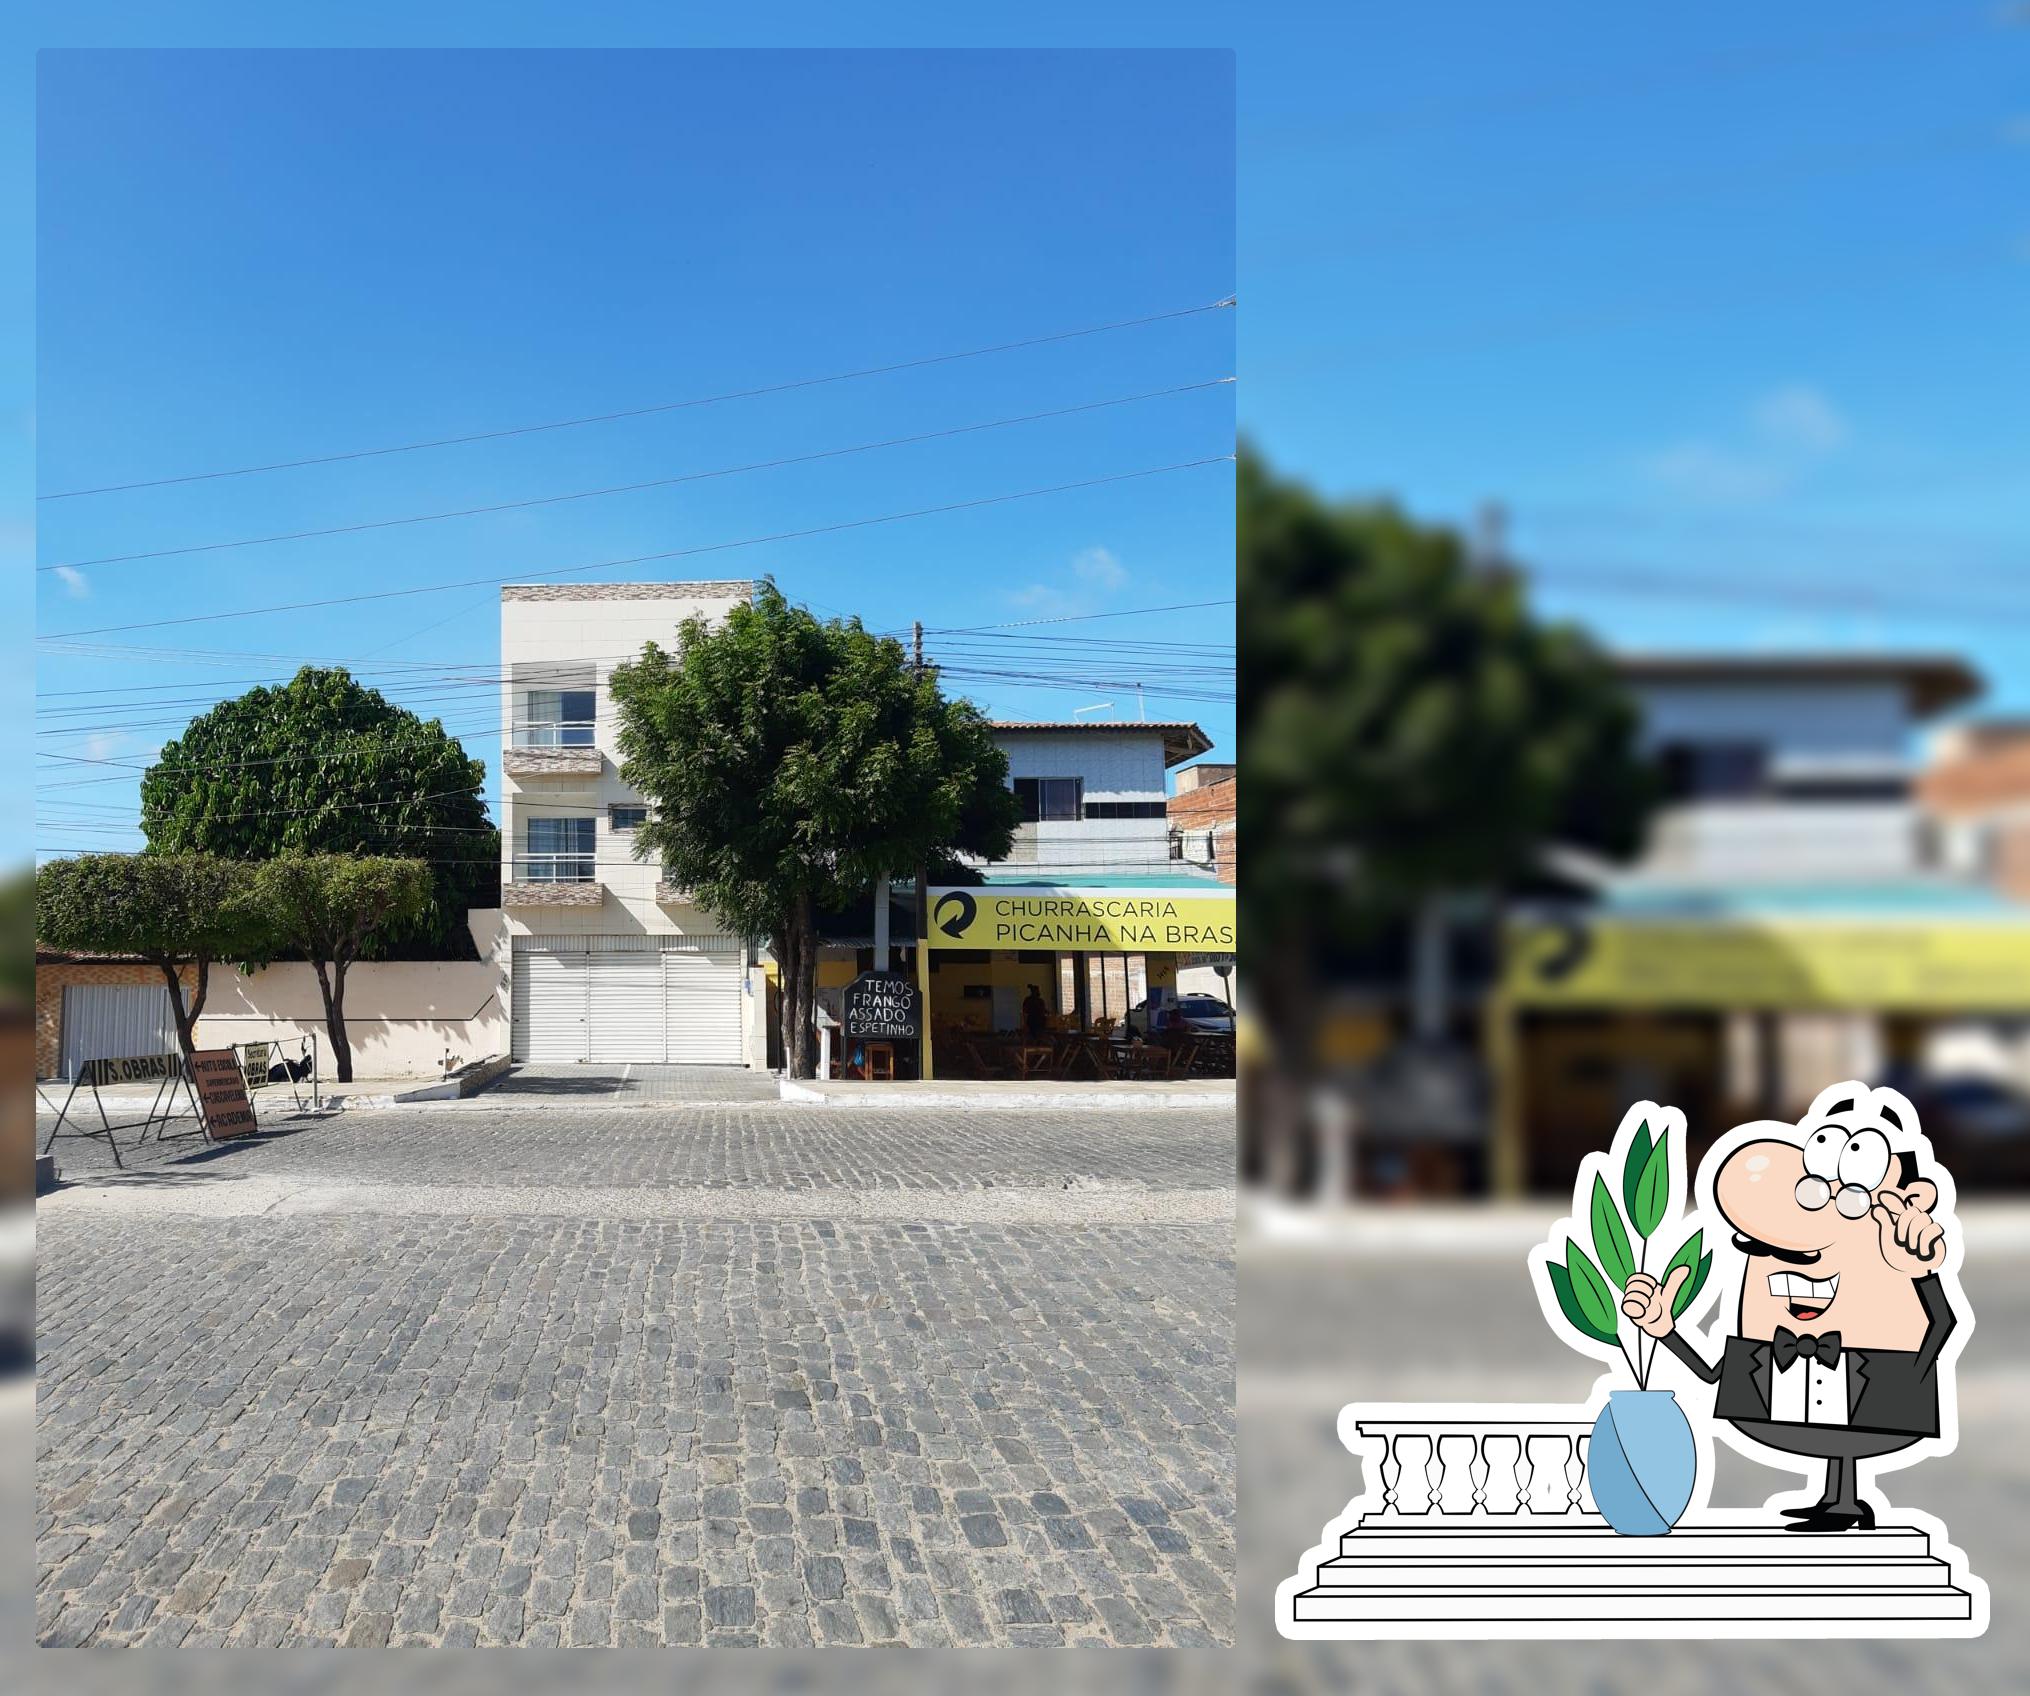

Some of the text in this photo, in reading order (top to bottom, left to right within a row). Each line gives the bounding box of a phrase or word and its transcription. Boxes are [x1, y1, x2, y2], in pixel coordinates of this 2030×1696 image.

[995, 900, 1178, 918] CHURRASCARIA
[996, 923, 1236, 944] PICANHA NA BRAS
[865, 979, 914, 997] TEMOS
[853, 992, 911, 1009] FRANGO
[849, 1007, 906, 1022] ASSADO
[850, 1022, 914, 1036] ESPETINHO
